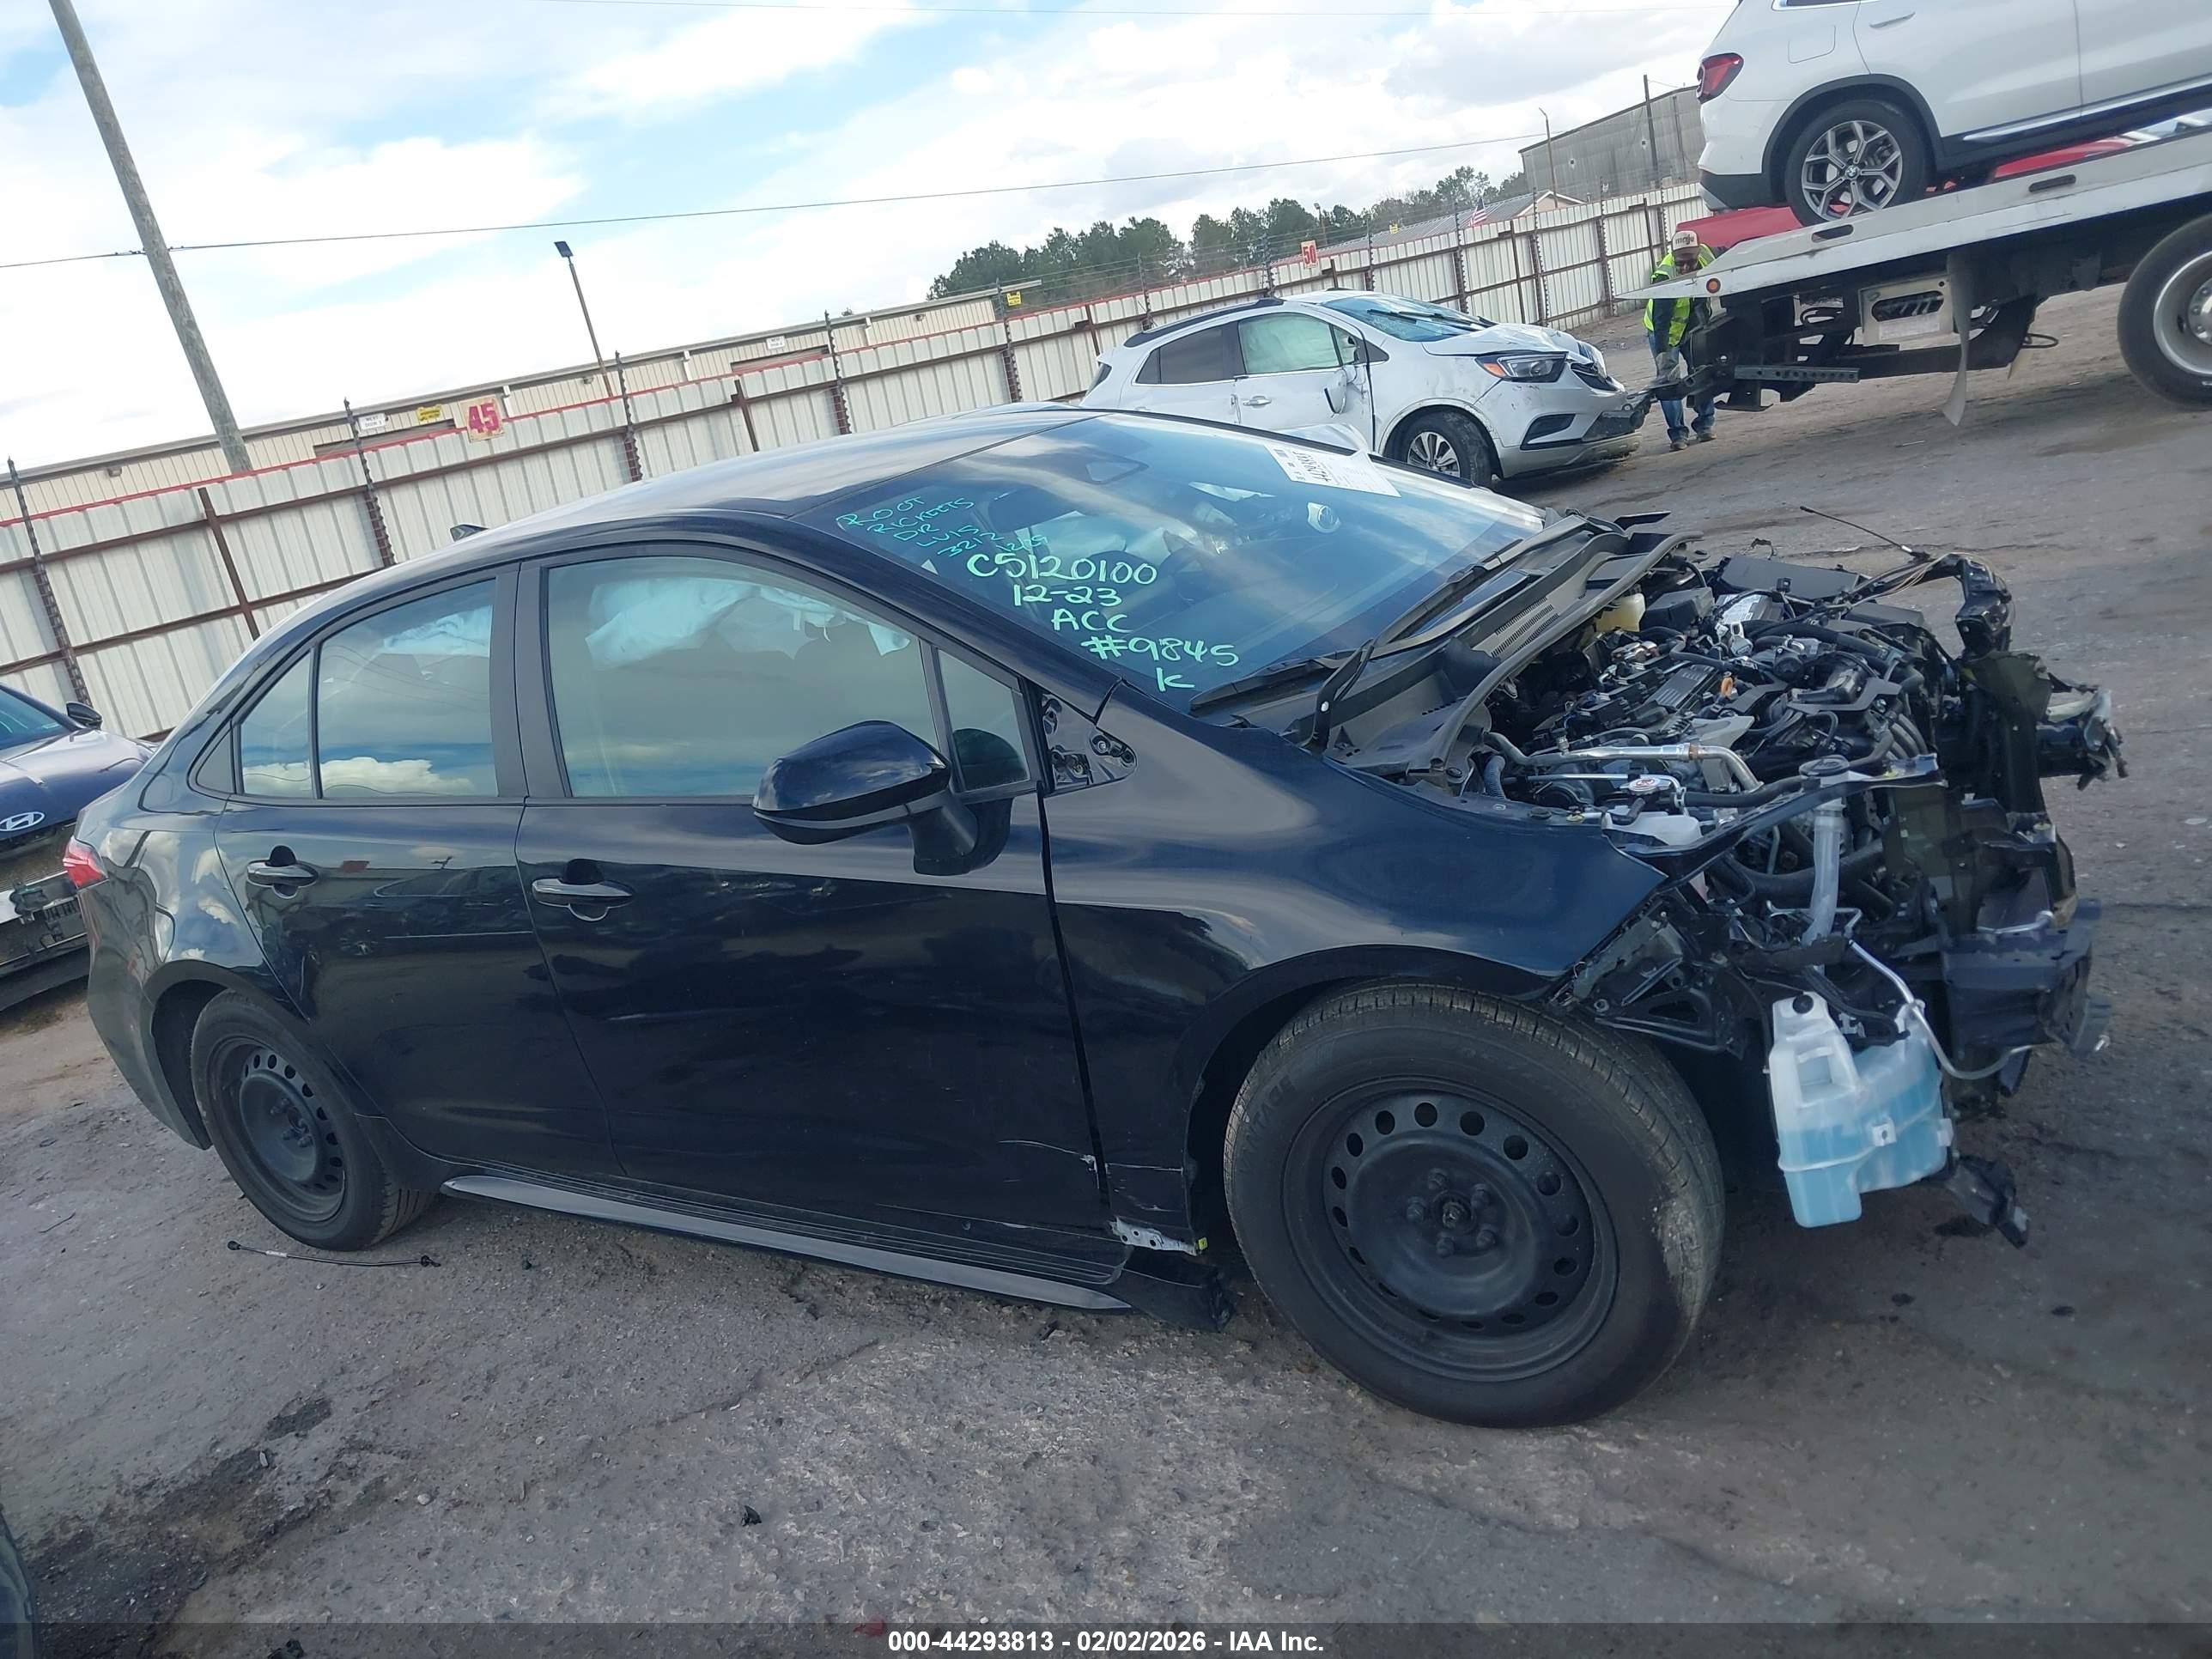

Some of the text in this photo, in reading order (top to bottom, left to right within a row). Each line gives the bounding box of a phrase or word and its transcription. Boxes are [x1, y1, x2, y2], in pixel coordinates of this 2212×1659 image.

[1303, 245, 1316, 264] 50
[468, 403, 500, 433] 45
[836, 496, 926, 531] ROOT
[894, 523, 939, 542] DR
[916, 525, 980, 547] LUIS
[938, 532, 1005, 557] 3212
[967, 552, 1158, 587] C5120100
[1013, 585, 1122, 606] 12-23
[1051, 608, 1130, 634] ACC
[1080, 635, 1240, 666] #9845
